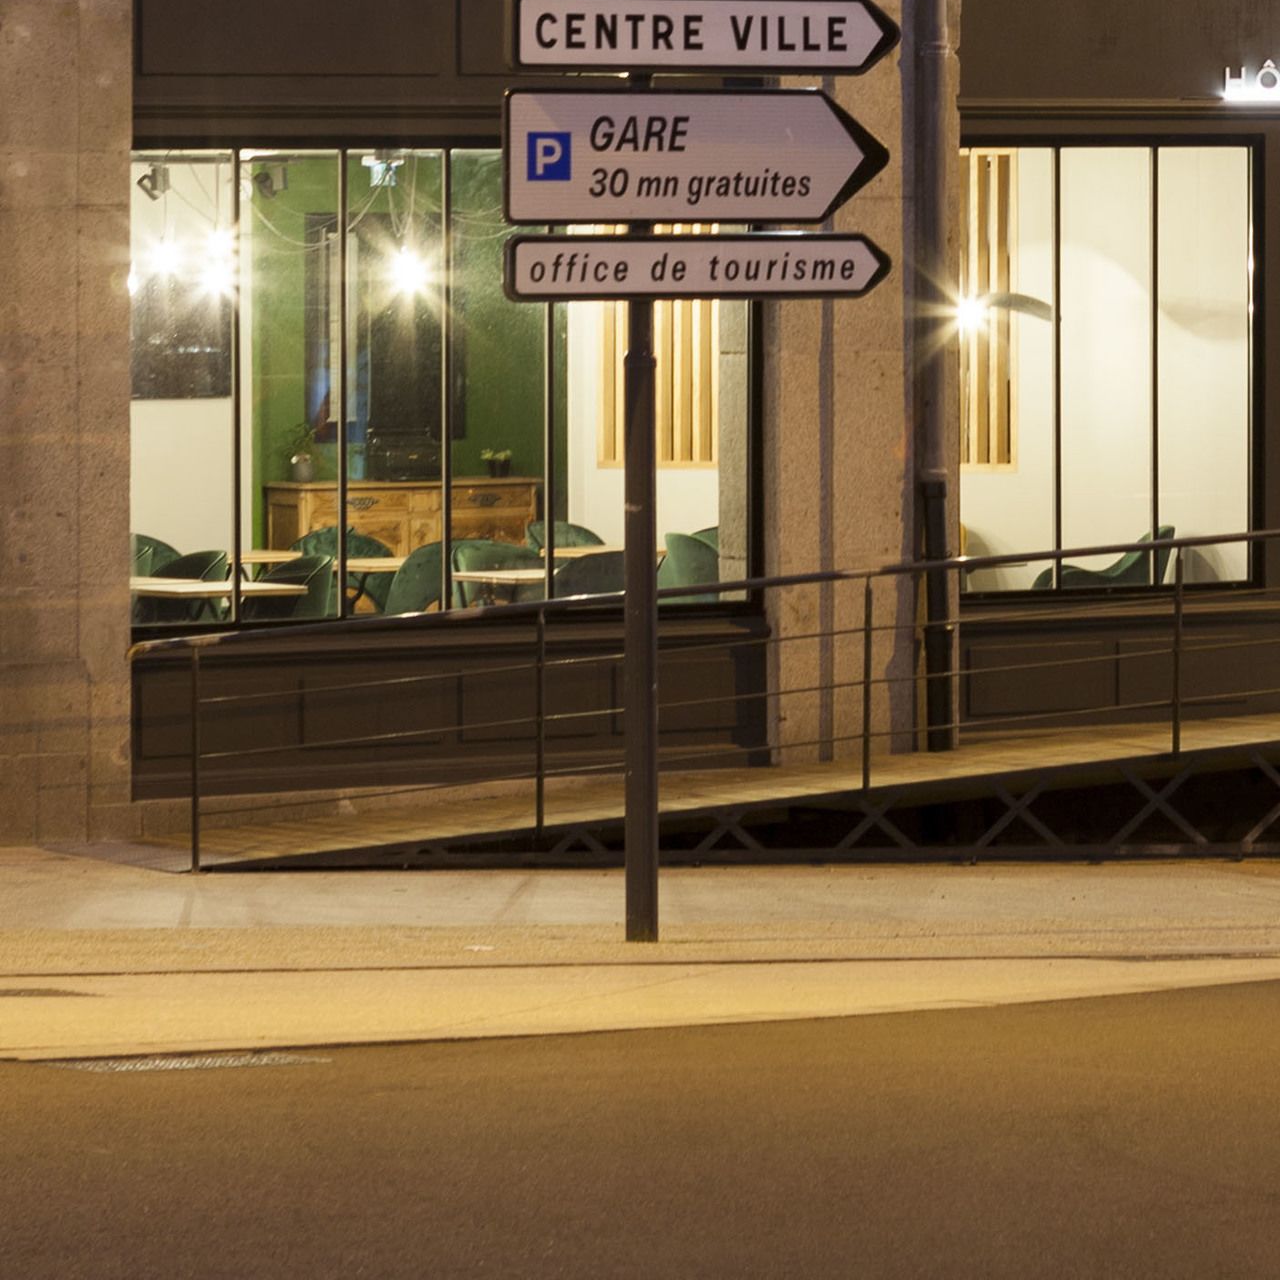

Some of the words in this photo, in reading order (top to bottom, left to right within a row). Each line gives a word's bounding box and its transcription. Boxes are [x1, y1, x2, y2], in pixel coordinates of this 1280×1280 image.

[534, 12, 704, 51] CENTRE
[730, 15, 849, 52] VILLE
[588, 115, 690, 153] GARE
[535, 138, 562, 176] P
[588, 167, 629, 198] 30
[636, 173, 679, 198] mn
[686, 170, 812, 206] gratuites
[529, 252, 629, 284] office
[650, 252, 687, 282] de
[708, 252, 856, 281] tourisme
